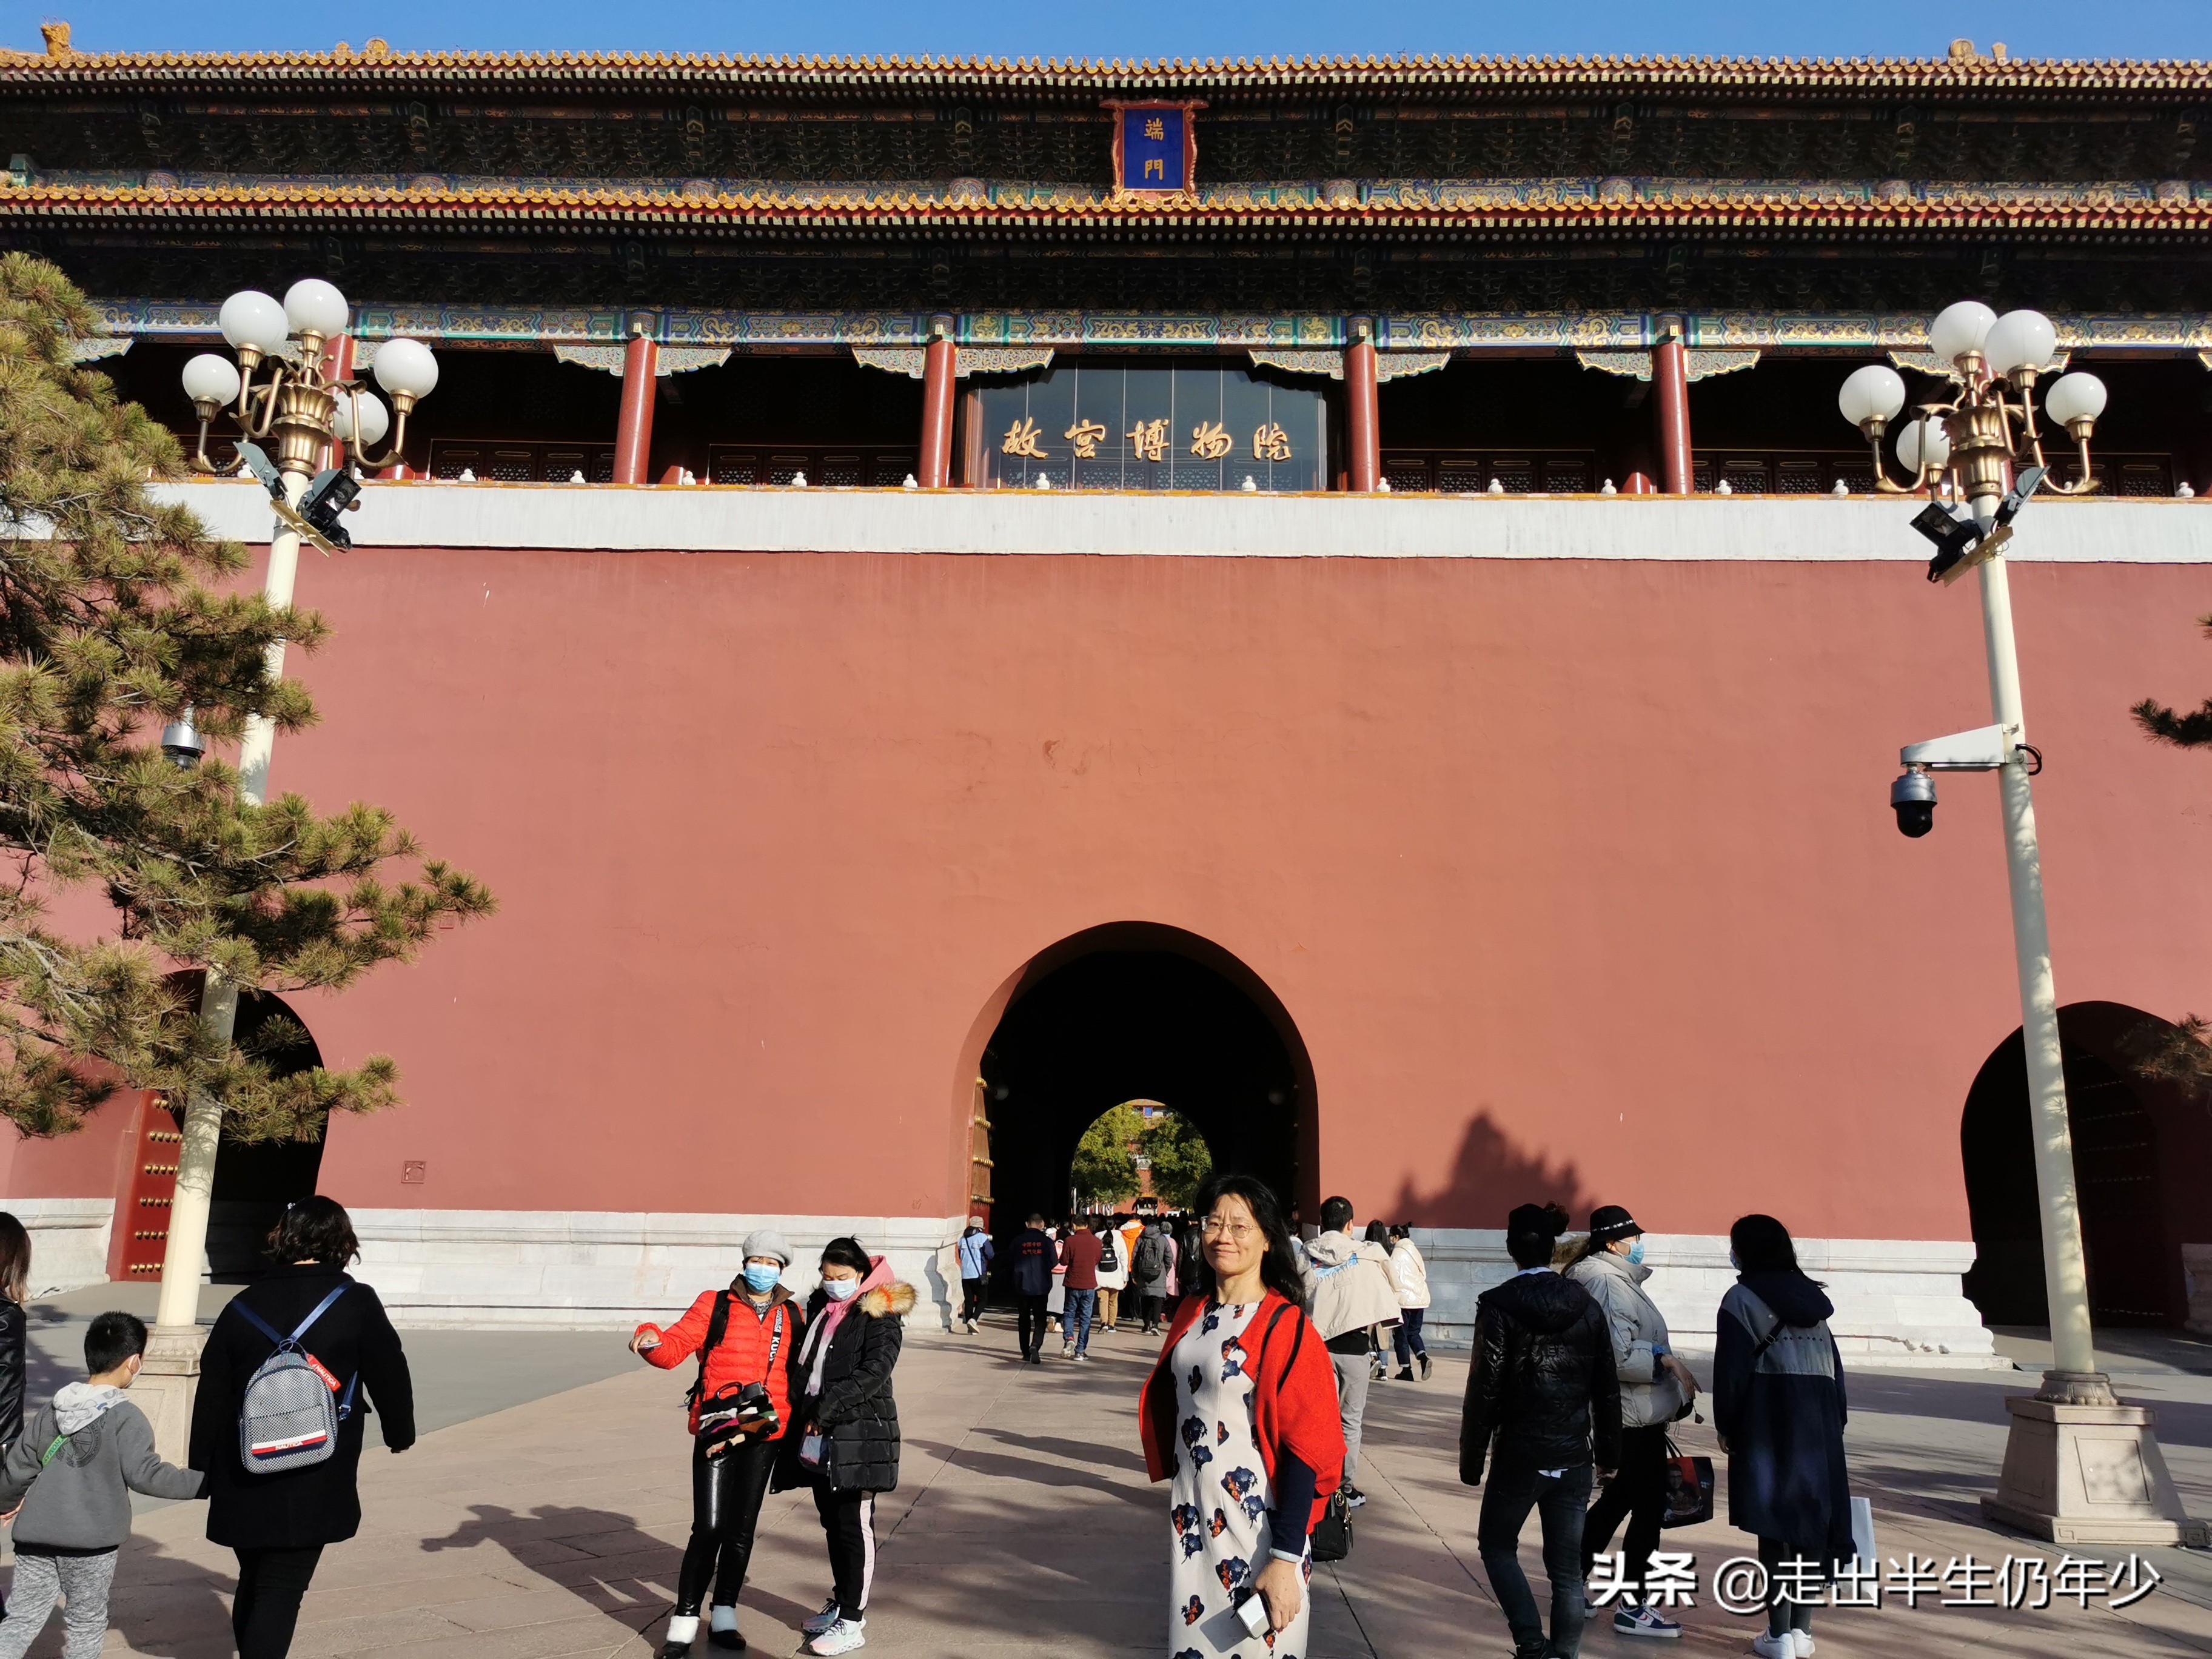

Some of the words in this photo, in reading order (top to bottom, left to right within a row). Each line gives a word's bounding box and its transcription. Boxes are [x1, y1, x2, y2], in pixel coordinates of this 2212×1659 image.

[1144, 117, 1164, 181] 端門
[1002, 417, 1292, 461] 故宫博物院
[315, 1364, 337, 1387] NAUTICA
[275, 1441, 304, 1450] NAUTICA
